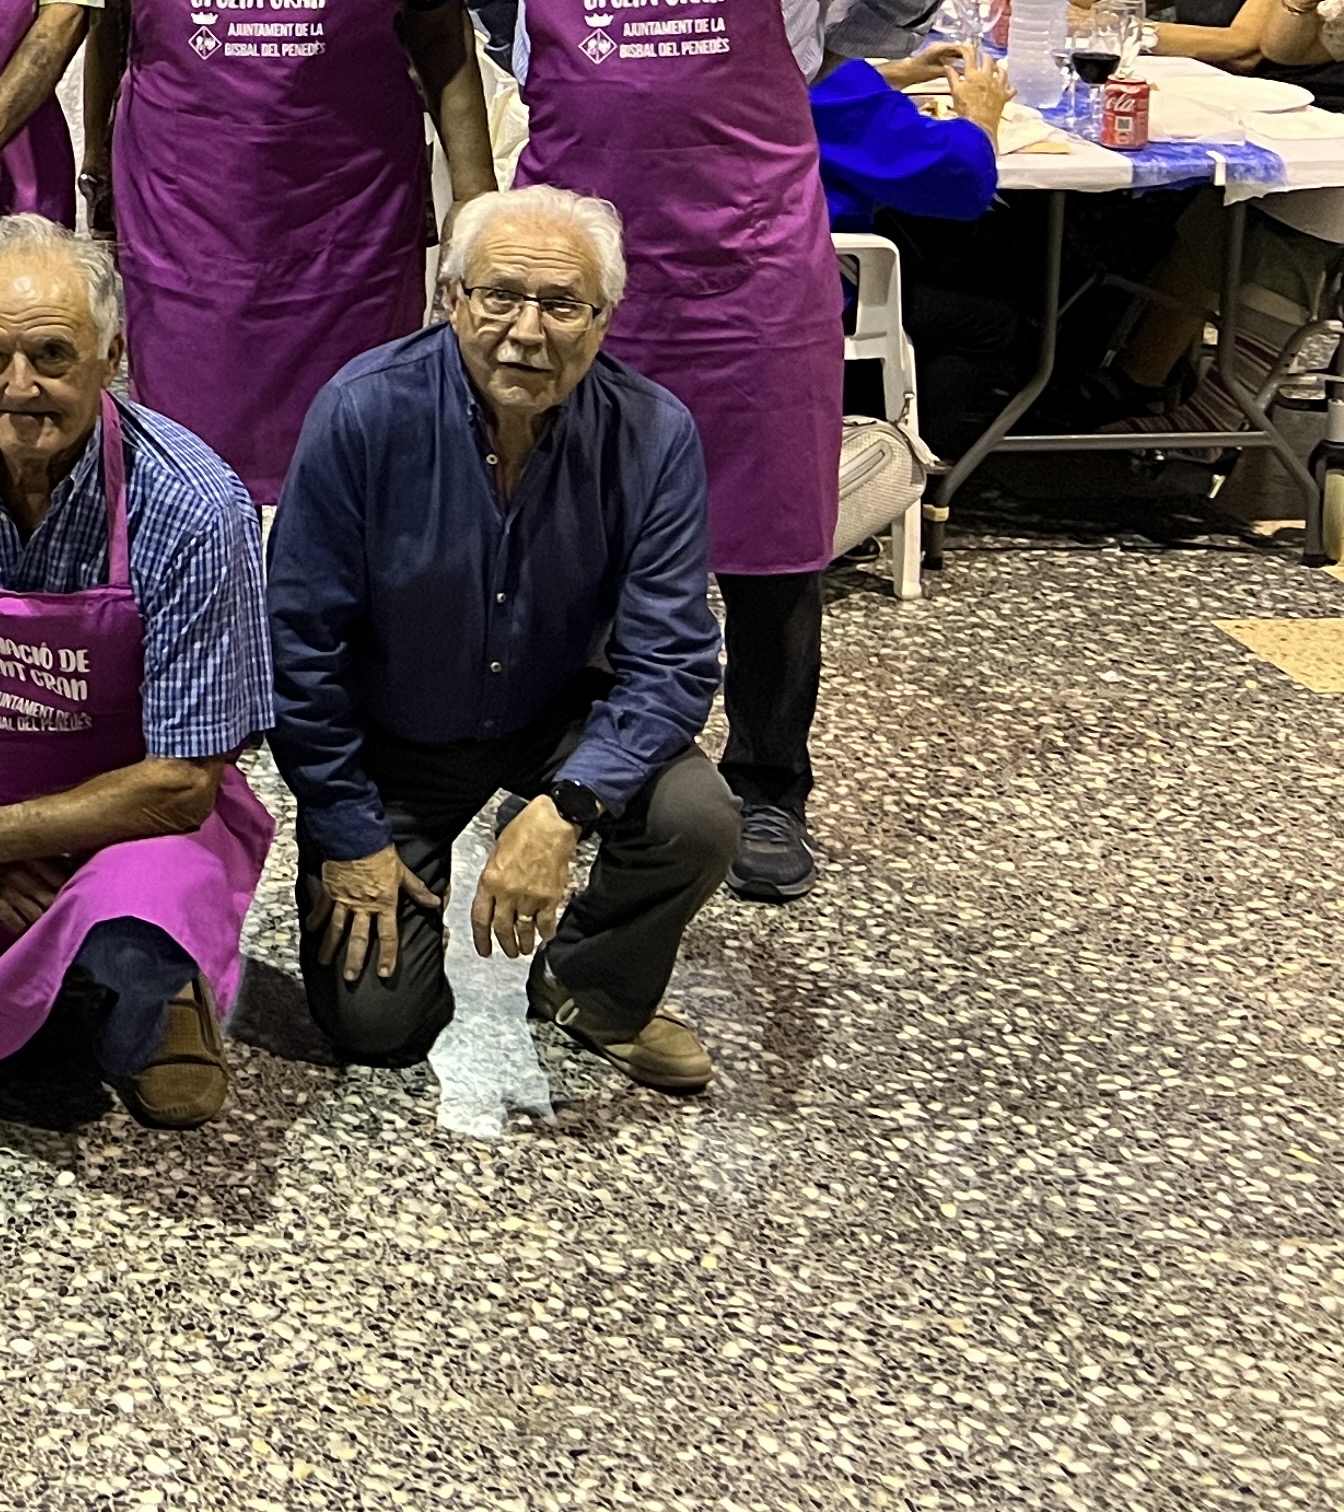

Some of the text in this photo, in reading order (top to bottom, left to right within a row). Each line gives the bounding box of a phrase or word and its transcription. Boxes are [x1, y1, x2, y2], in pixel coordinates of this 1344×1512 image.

[227, 22, 324, 37] AJUNTAMENT DE LA
[623, 17, 726, 37] AJUNTAMENT DE LA
[224, 39, 326, 58] BISBAL DEL PENEDÈS
[619, 36, 730, 59] BISBAL DEL PENEDÈS
[57, 649, 91, 673] DE
[29, 669, 88, 701] GRAN
[16, 716, 40, 732] DEL
